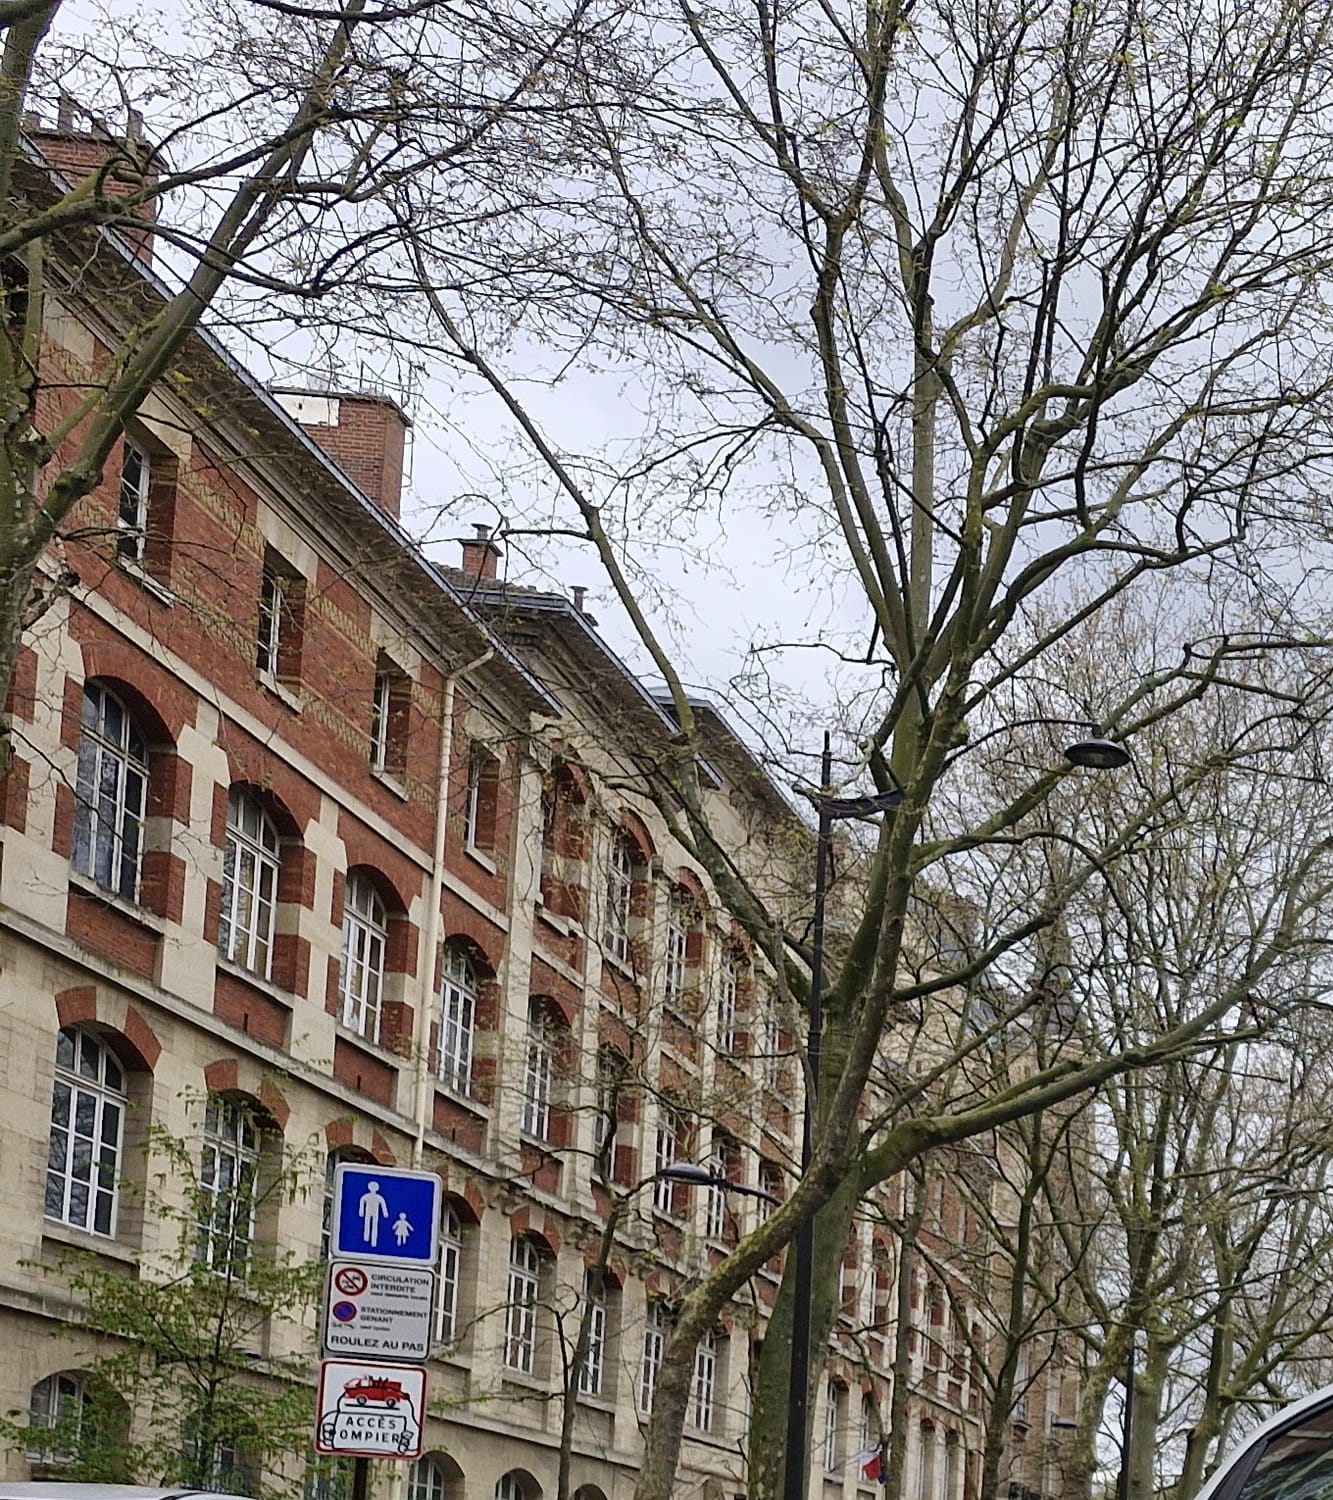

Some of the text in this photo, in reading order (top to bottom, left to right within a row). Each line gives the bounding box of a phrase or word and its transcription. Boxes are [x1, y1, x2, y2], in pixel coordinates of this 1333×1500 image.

[371, 1273, 429, 1286] CIRCULATION
[370, 1283, 416, 1293] INTERDITE
[360, 1306, 428, 1318] STATIONNEMENT
[330, 1335, 424, 1352] ROULEZ AU PAS
[345, 1415, 396, 1429] ACCÈS
